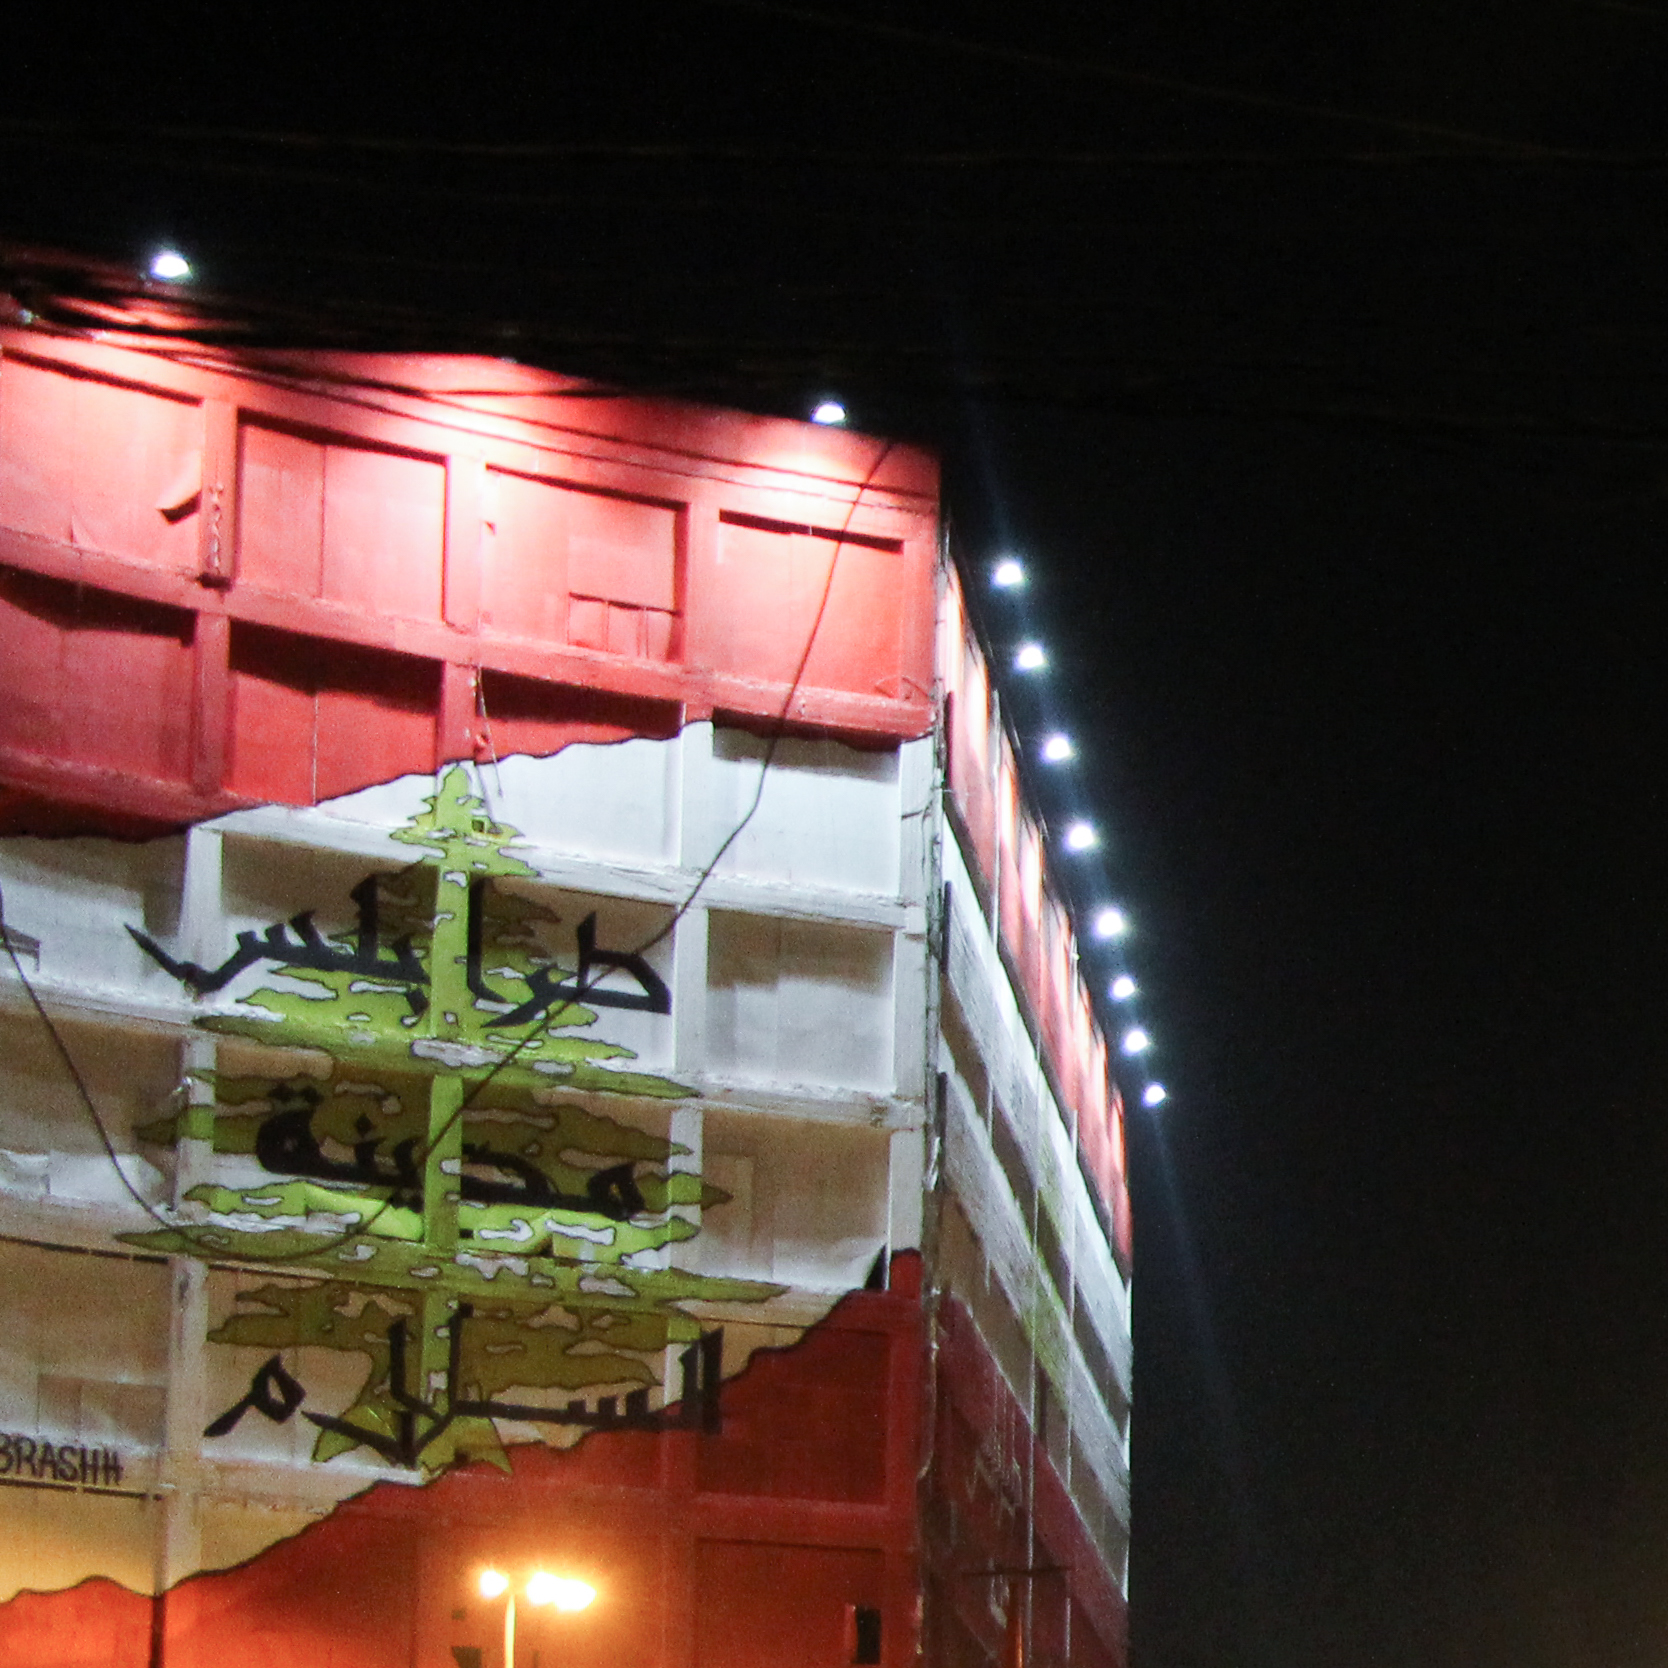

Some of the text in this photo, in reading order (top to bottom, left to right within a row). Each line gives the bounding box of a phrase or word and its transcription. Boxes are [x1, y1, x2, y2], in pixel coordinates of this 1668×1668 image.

[125, 876, 672, 1030] طرابلس
[255, 1081, 646, 1222] مدينة
[204, 1303, 724, 1470] السلام
